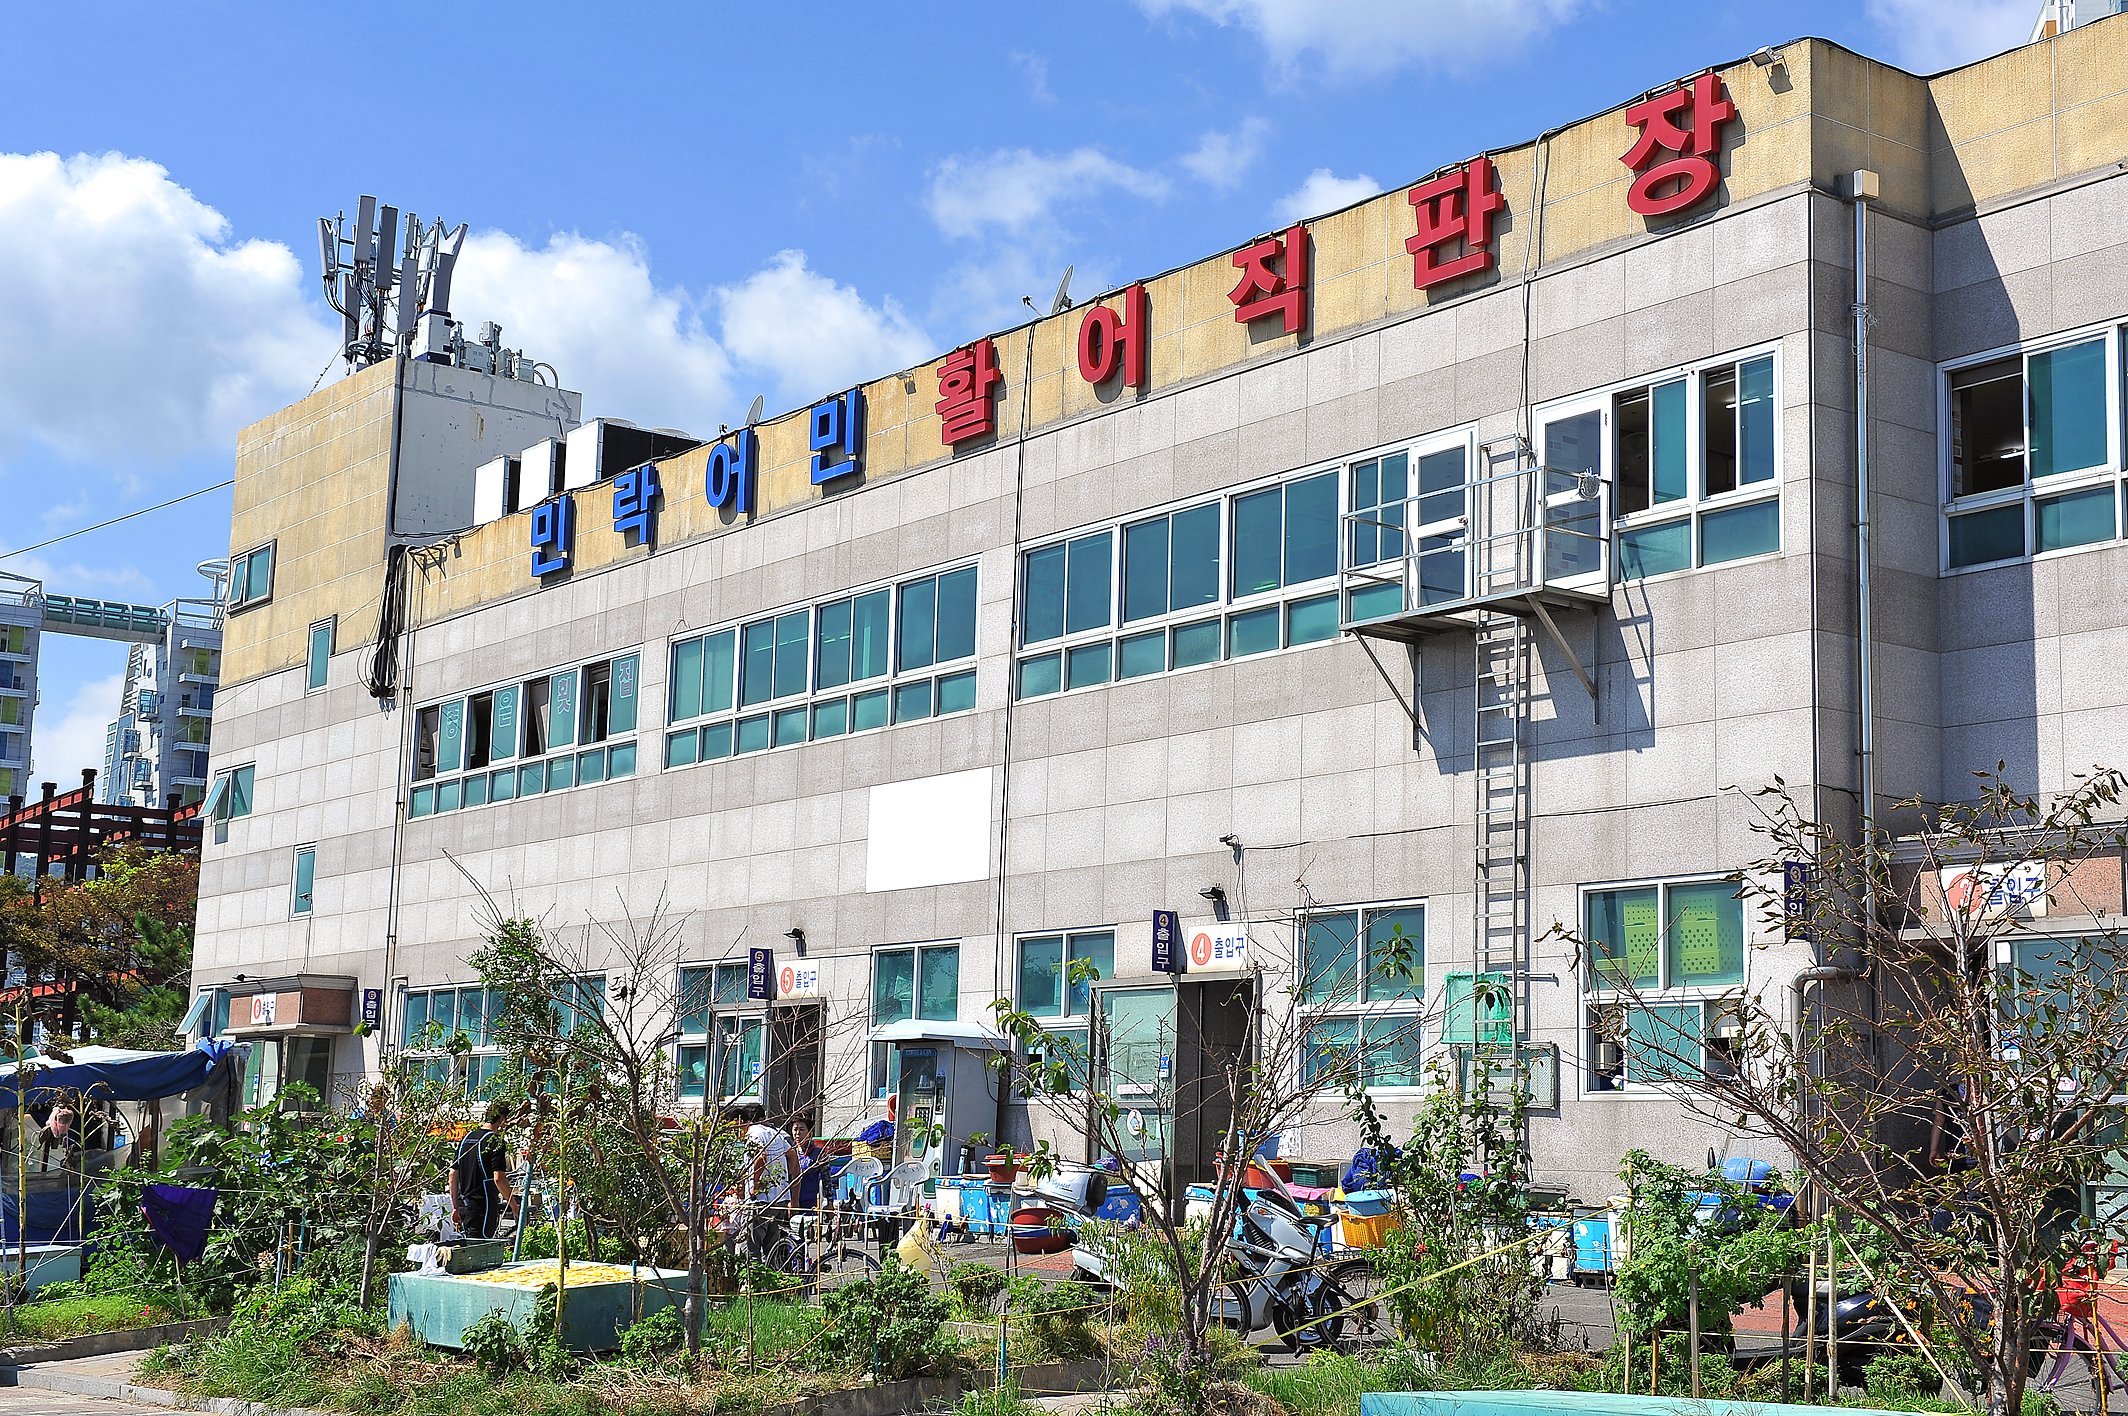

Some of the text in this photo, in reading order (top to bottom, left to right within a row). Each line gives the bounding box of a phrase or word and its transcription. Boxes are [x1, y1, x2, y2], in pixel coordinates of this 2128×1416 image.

[531, 73, 1735, 577] 민락어민 활어직판장
[557, 659, 635, 714] 횟집
[1156, 928, 1170, 969] 출입구
[1214, 937, 1245, 959] 출입구
[751, 962, 765, 997] 출입구
[795, 970, 817, 988] 출입구
